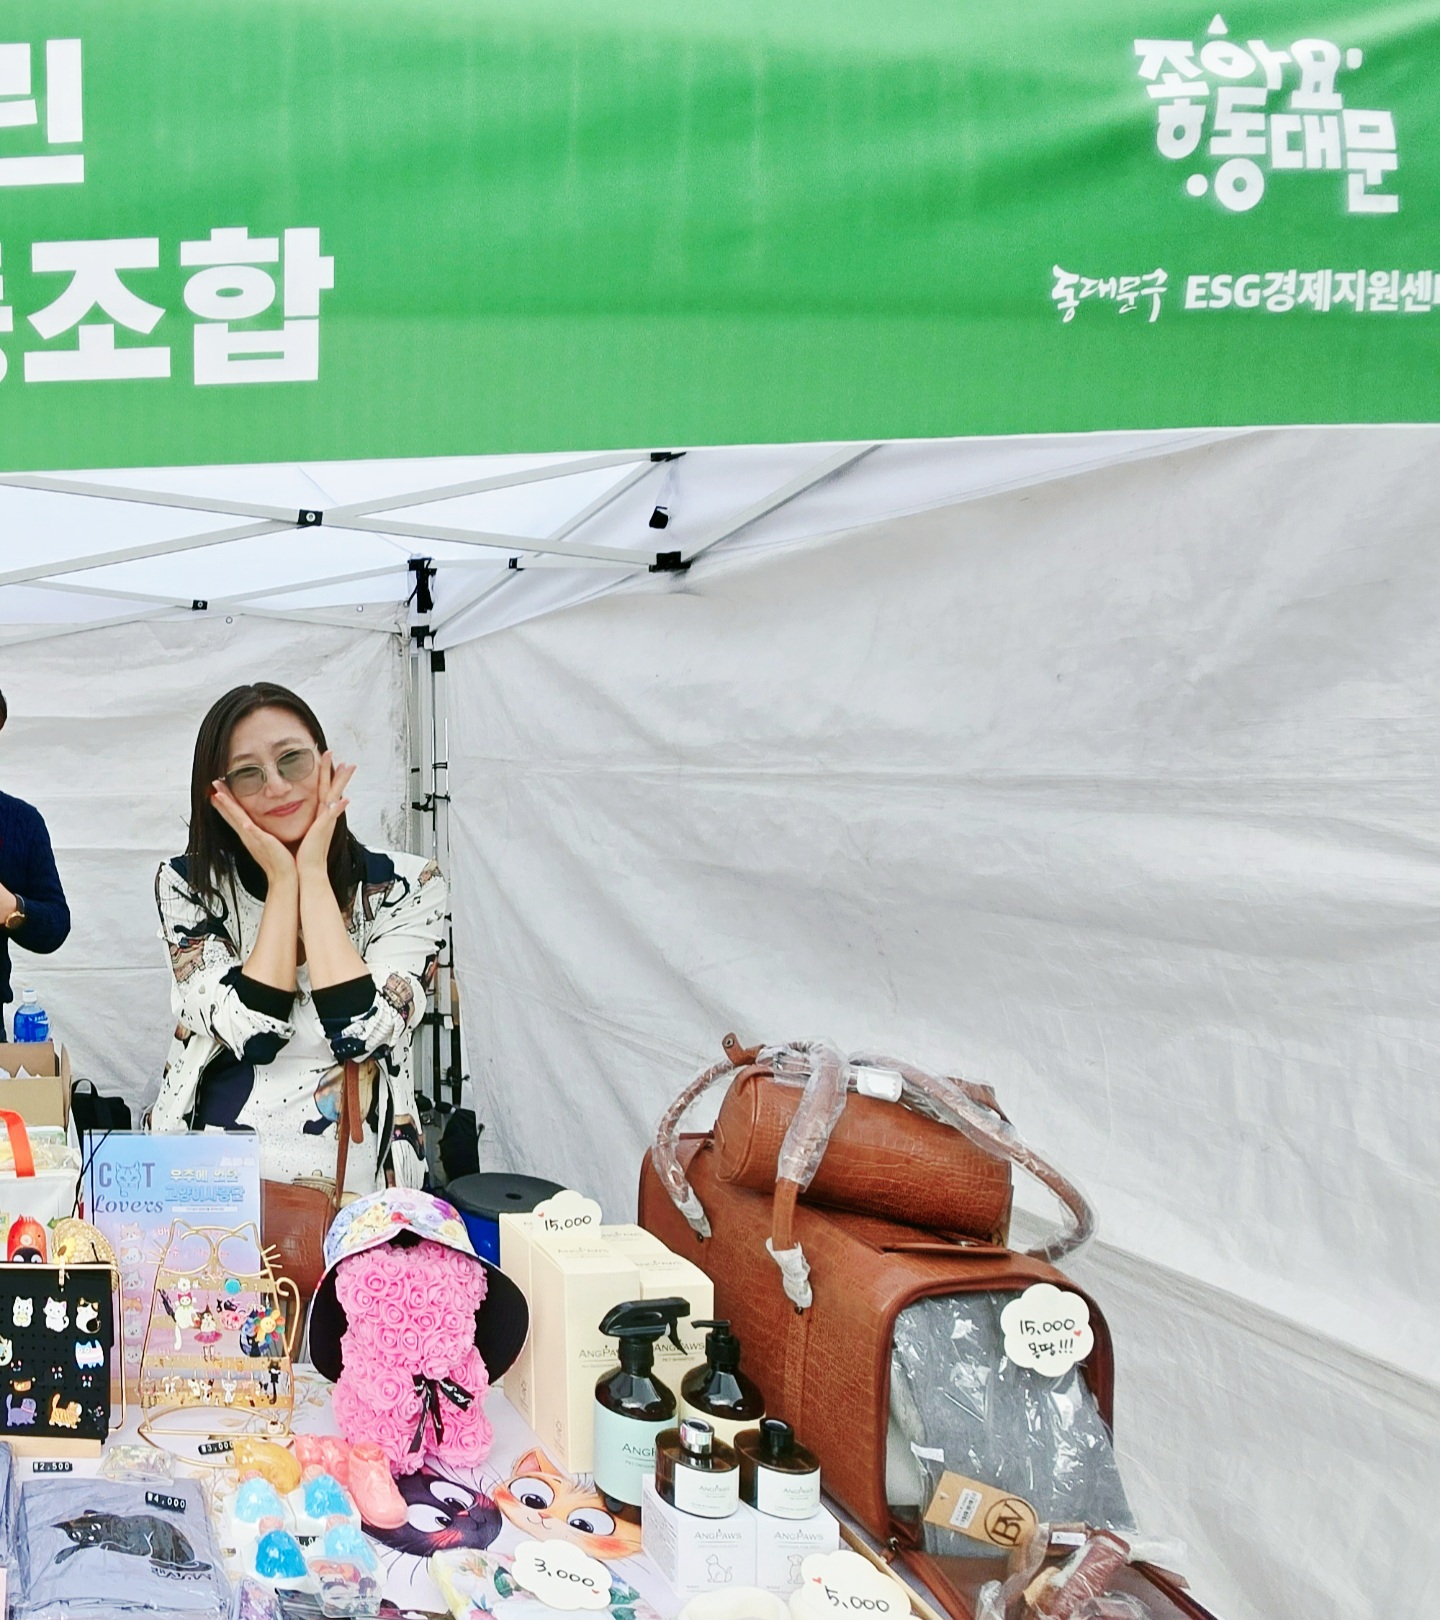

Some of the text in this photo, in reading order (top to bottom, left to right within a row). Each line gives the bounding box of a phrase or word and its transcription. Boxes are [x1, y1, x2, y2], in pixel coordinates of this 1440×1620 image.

[1051, 264, 1440, 323] 동대문구 ESG경제지원센
[95, 1194, 164, 1213] Lovers
[544, 1215, 592, 1232] 15,000
[1019, 1318, 1076, 1335] 15,000
[533, 1556, 596, 1589] 3,000
[824, 1585, 891, 1613] 5,000
